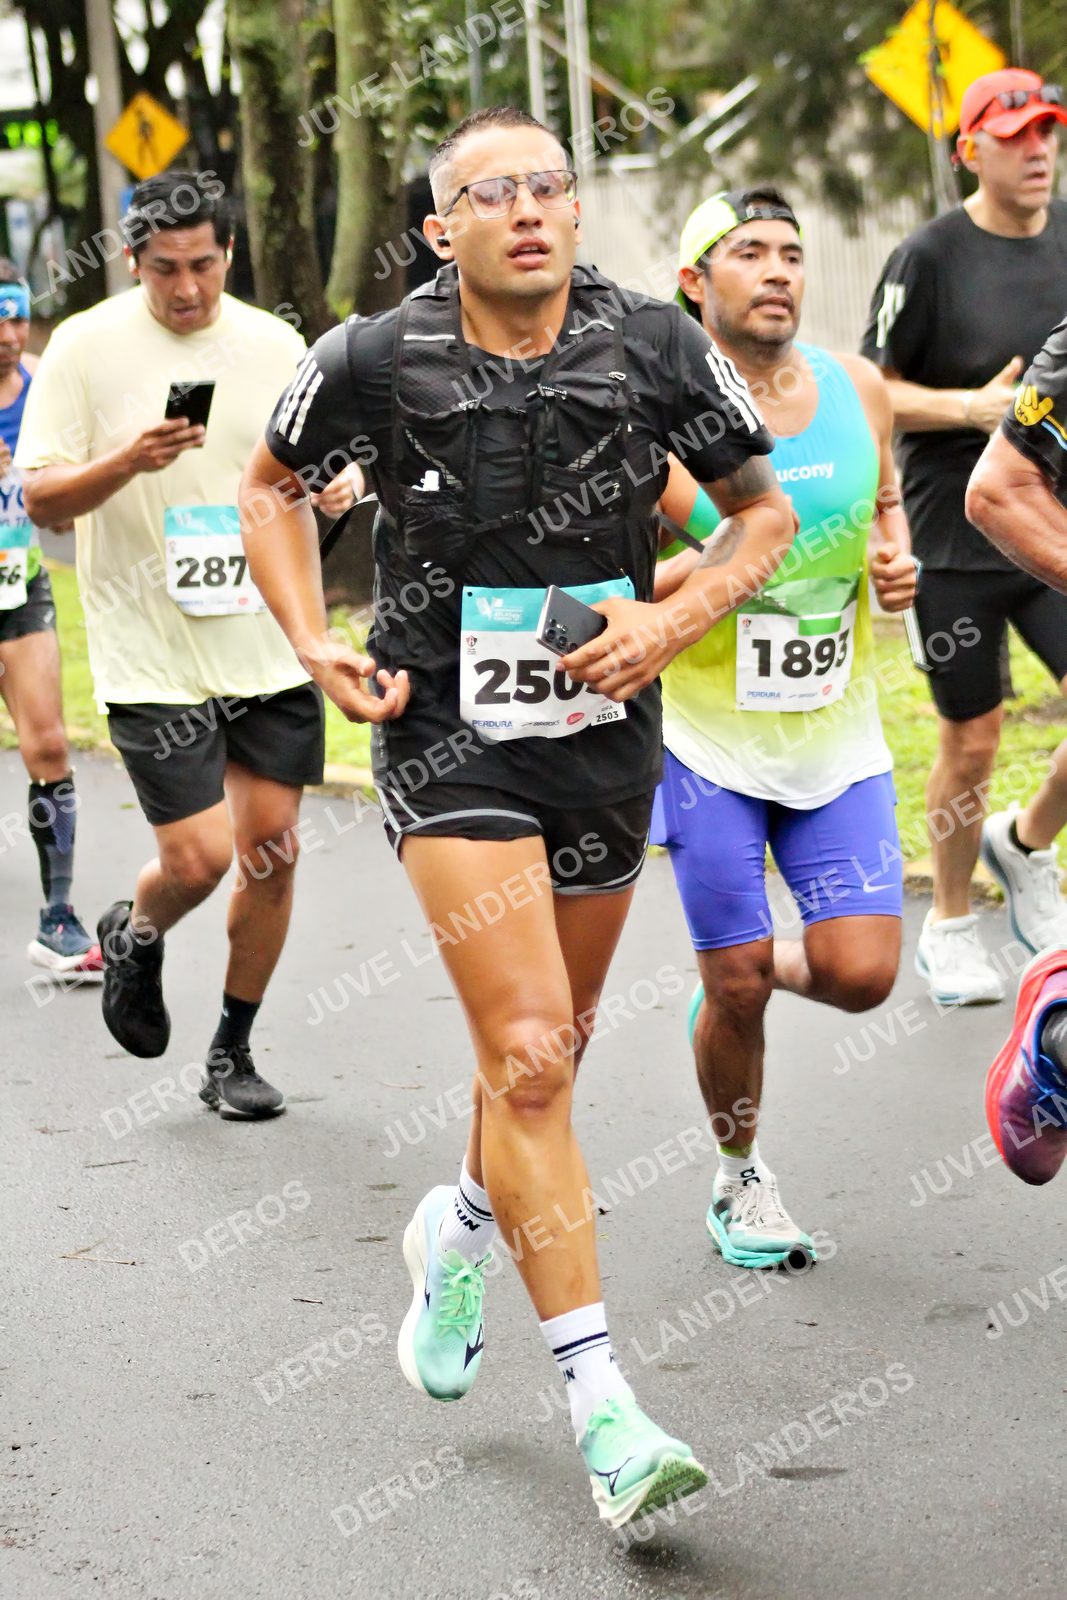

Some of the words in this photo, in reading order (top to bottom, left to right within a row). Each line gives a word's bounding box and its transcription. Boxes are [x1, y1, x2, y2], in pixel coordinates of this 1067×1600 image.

[176, 556, 247, 588] 287
[752, 628, 850, 678] 1893
[473, 658, 601, 705] 250
[472, 719, 513, 729] PERDURA
[596, 711, 619, 722] 2503
